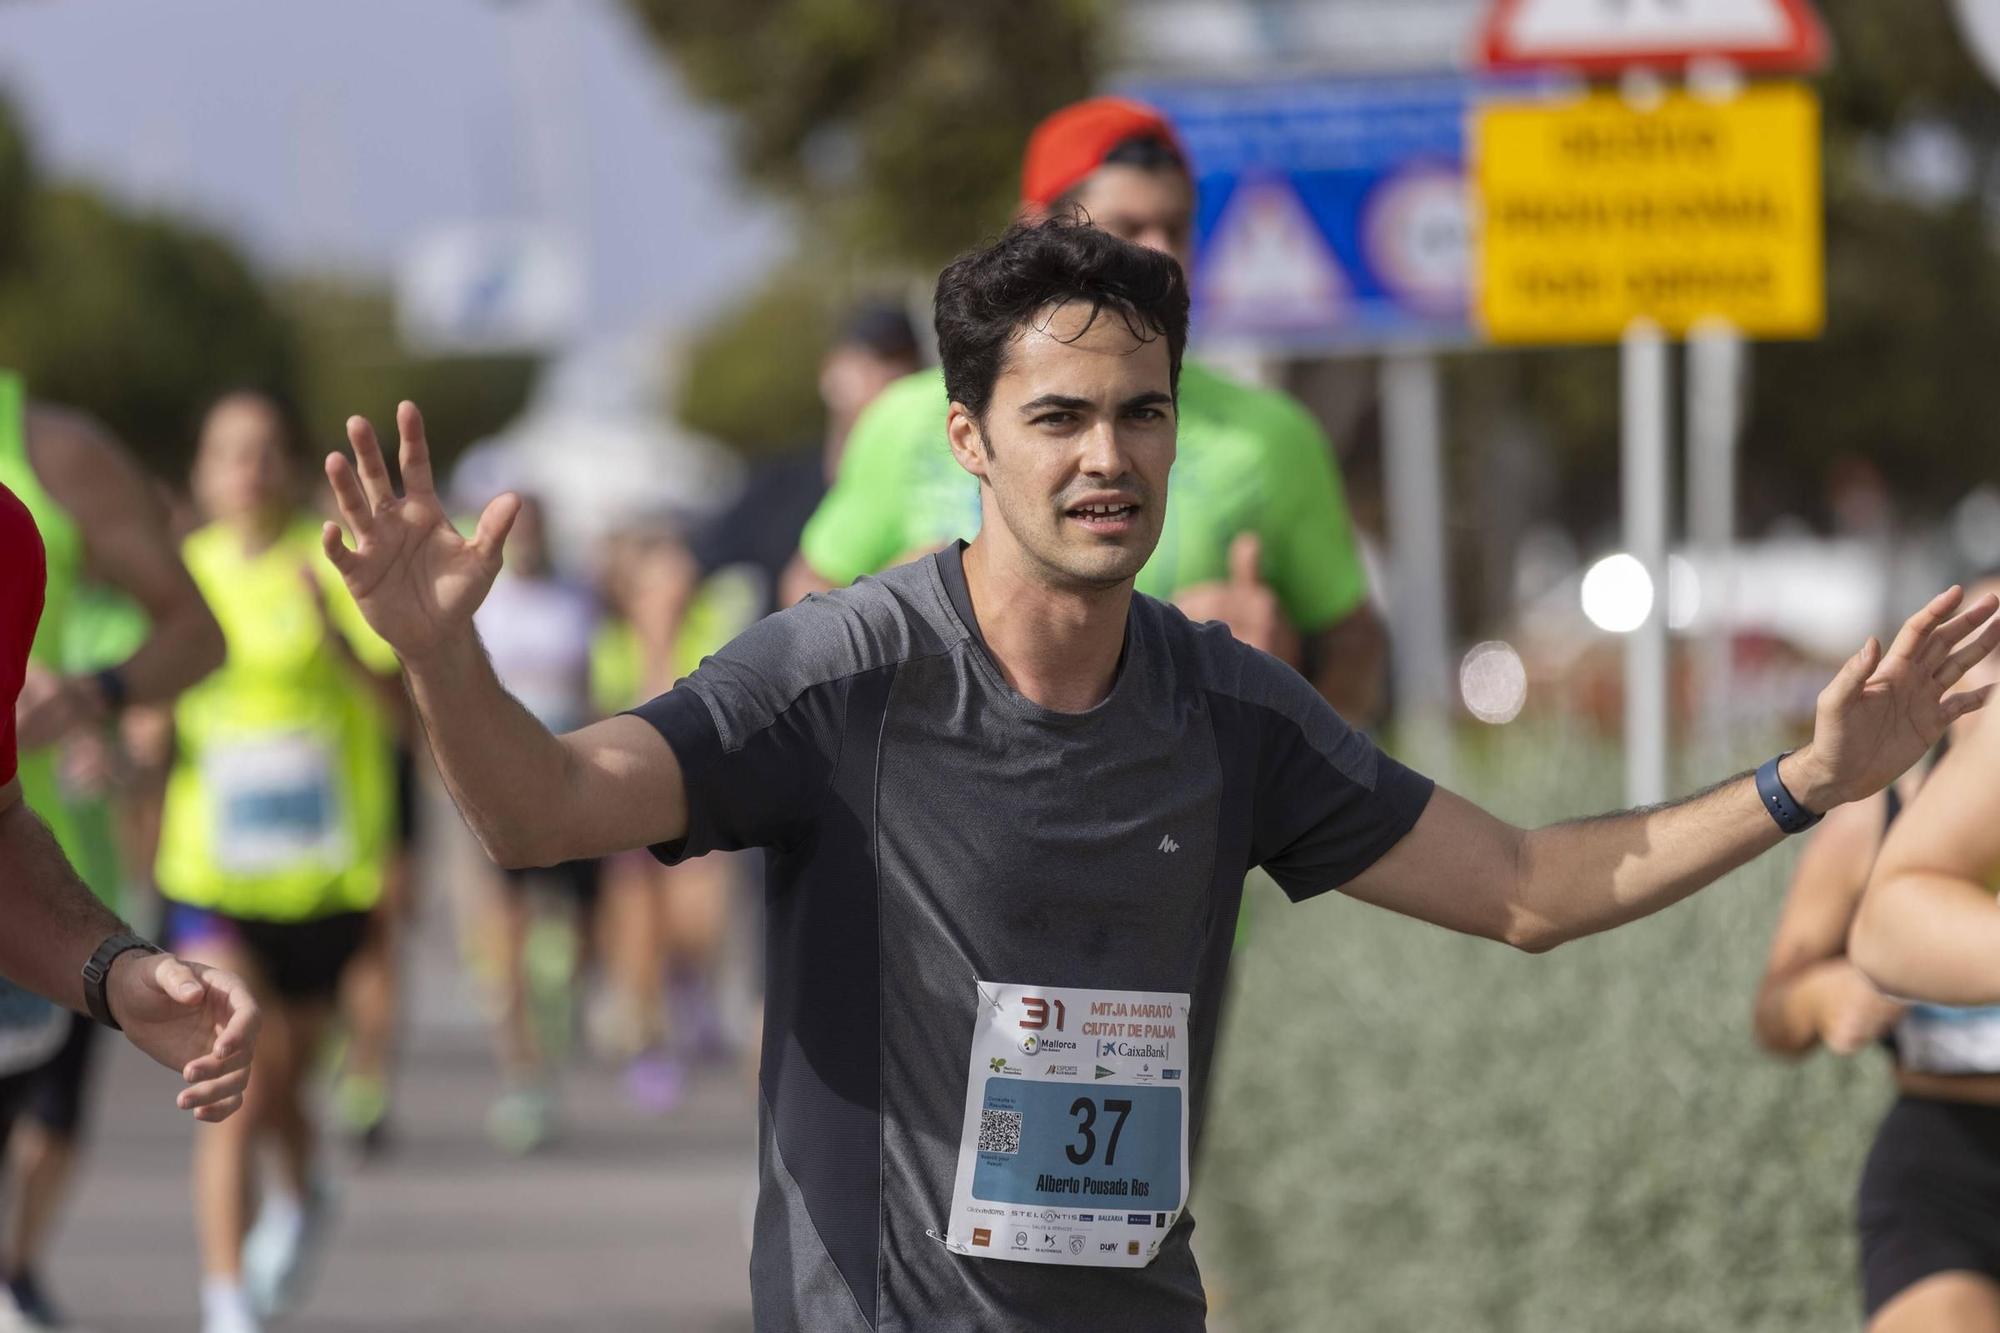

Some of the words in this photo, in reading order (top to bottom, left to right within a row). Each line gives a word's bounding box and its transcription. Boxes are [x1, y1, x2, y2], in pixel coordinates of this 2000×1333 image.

[1019, 997, 1065, 1031] 31
[1091, 1002, 1127, 1016] MITJA
[1130, 1003, 1172, 1018] MARATÓ
[1082, 1022, 1126, 1037] CIUTAT
[1127, 1024, 1143, 1037] DE
[1145, 1025, 1176, 1039] PALMA
[1041, 1039, 1076, 1049] Mallorca
[1118, 1043, 1166, 1058] CaixaBank
[1065, 1096, 1132, 1166] 37
[1036, 1174, 1080, 1194] Alberto
[1083, 1177, 1128, 1196] Pousada
[1131, 1179, 1150, 1196] Ros
[1011, 1210, 1077, 1220] STELLANTIS
